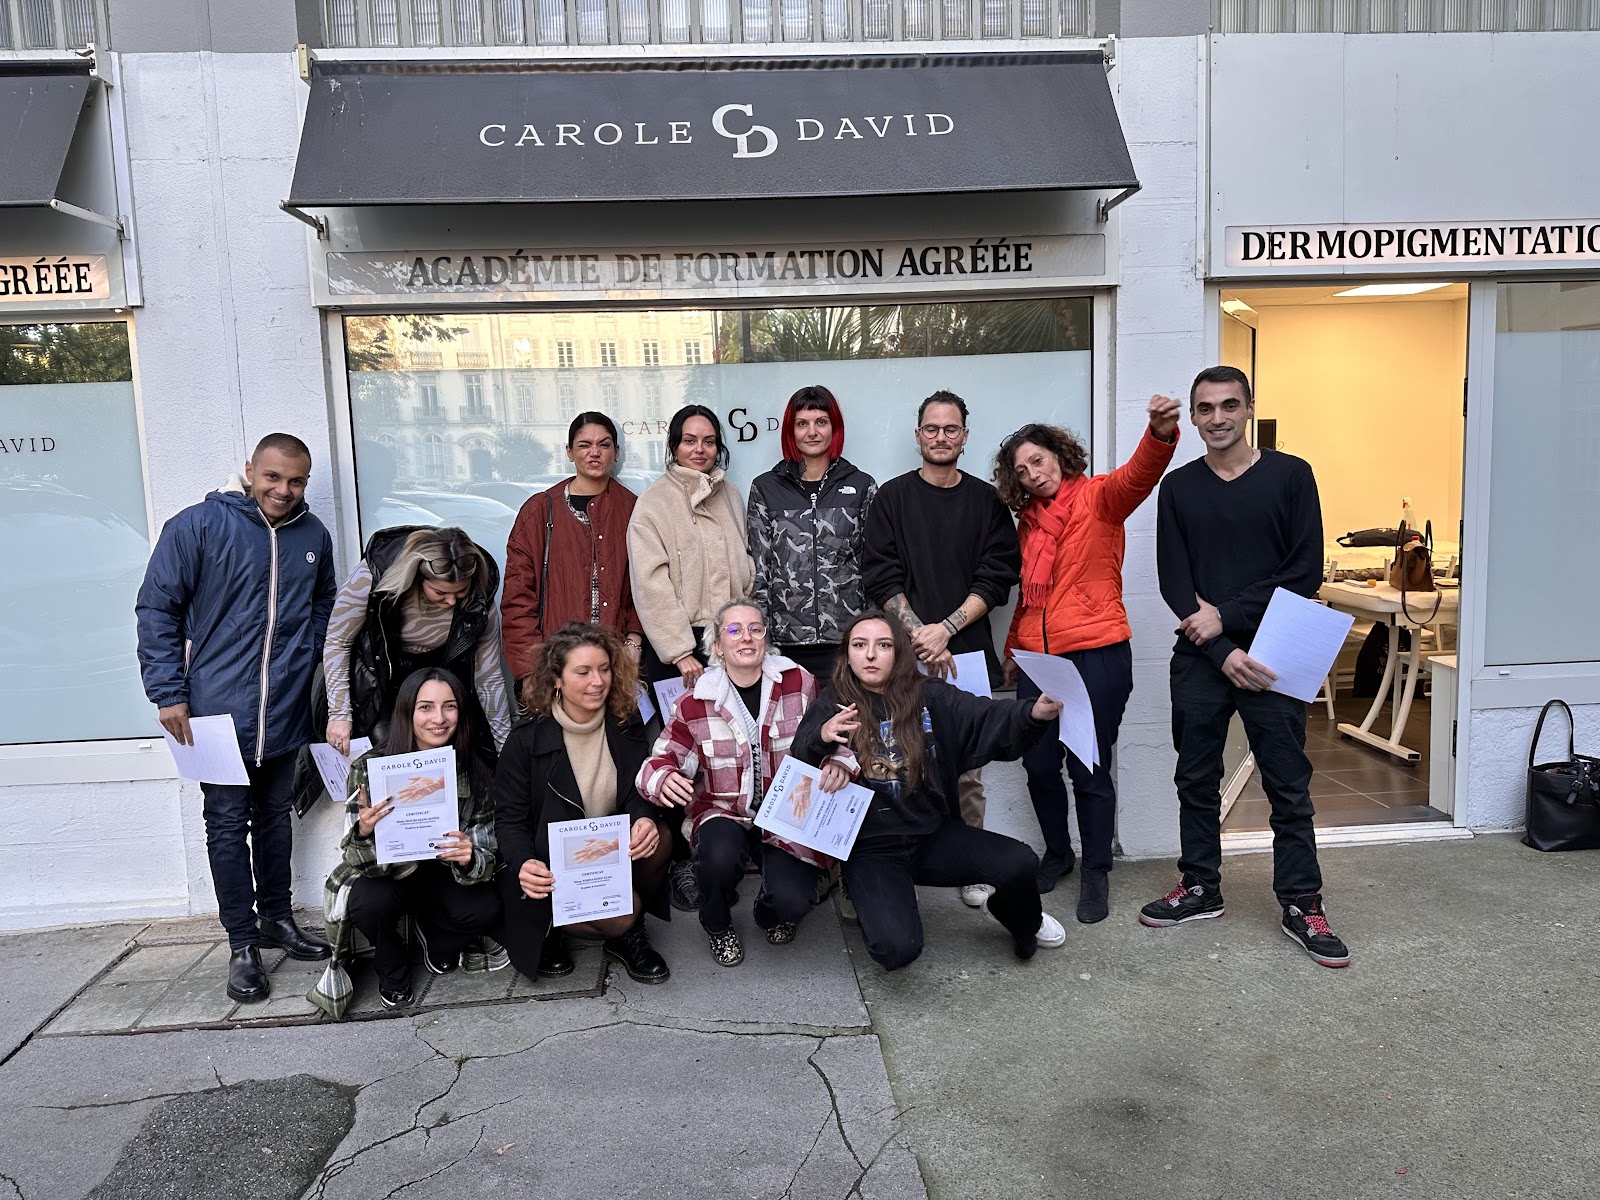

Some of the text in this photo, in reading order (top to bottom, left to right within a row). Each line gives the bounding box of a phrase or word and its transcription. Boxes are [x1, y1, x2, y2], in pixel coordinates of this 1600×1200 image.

[478, 103, 955, 159] CAROLE CD DAVID
[406, 238, 1033, 286] ACADÉMIE DE FORMATION AGRÉÉE
[622, 420, 669, 436] CAR
[728, 408, 758, 442] CD
[381, 762, 412, 771] CAROLE
[424, 757, 447, 765] DAVID
[764, 794, 778, 818] CAROLE
[781, 764, 791, 784] DAVID
[559, 825, 588, 833] CAROLE
